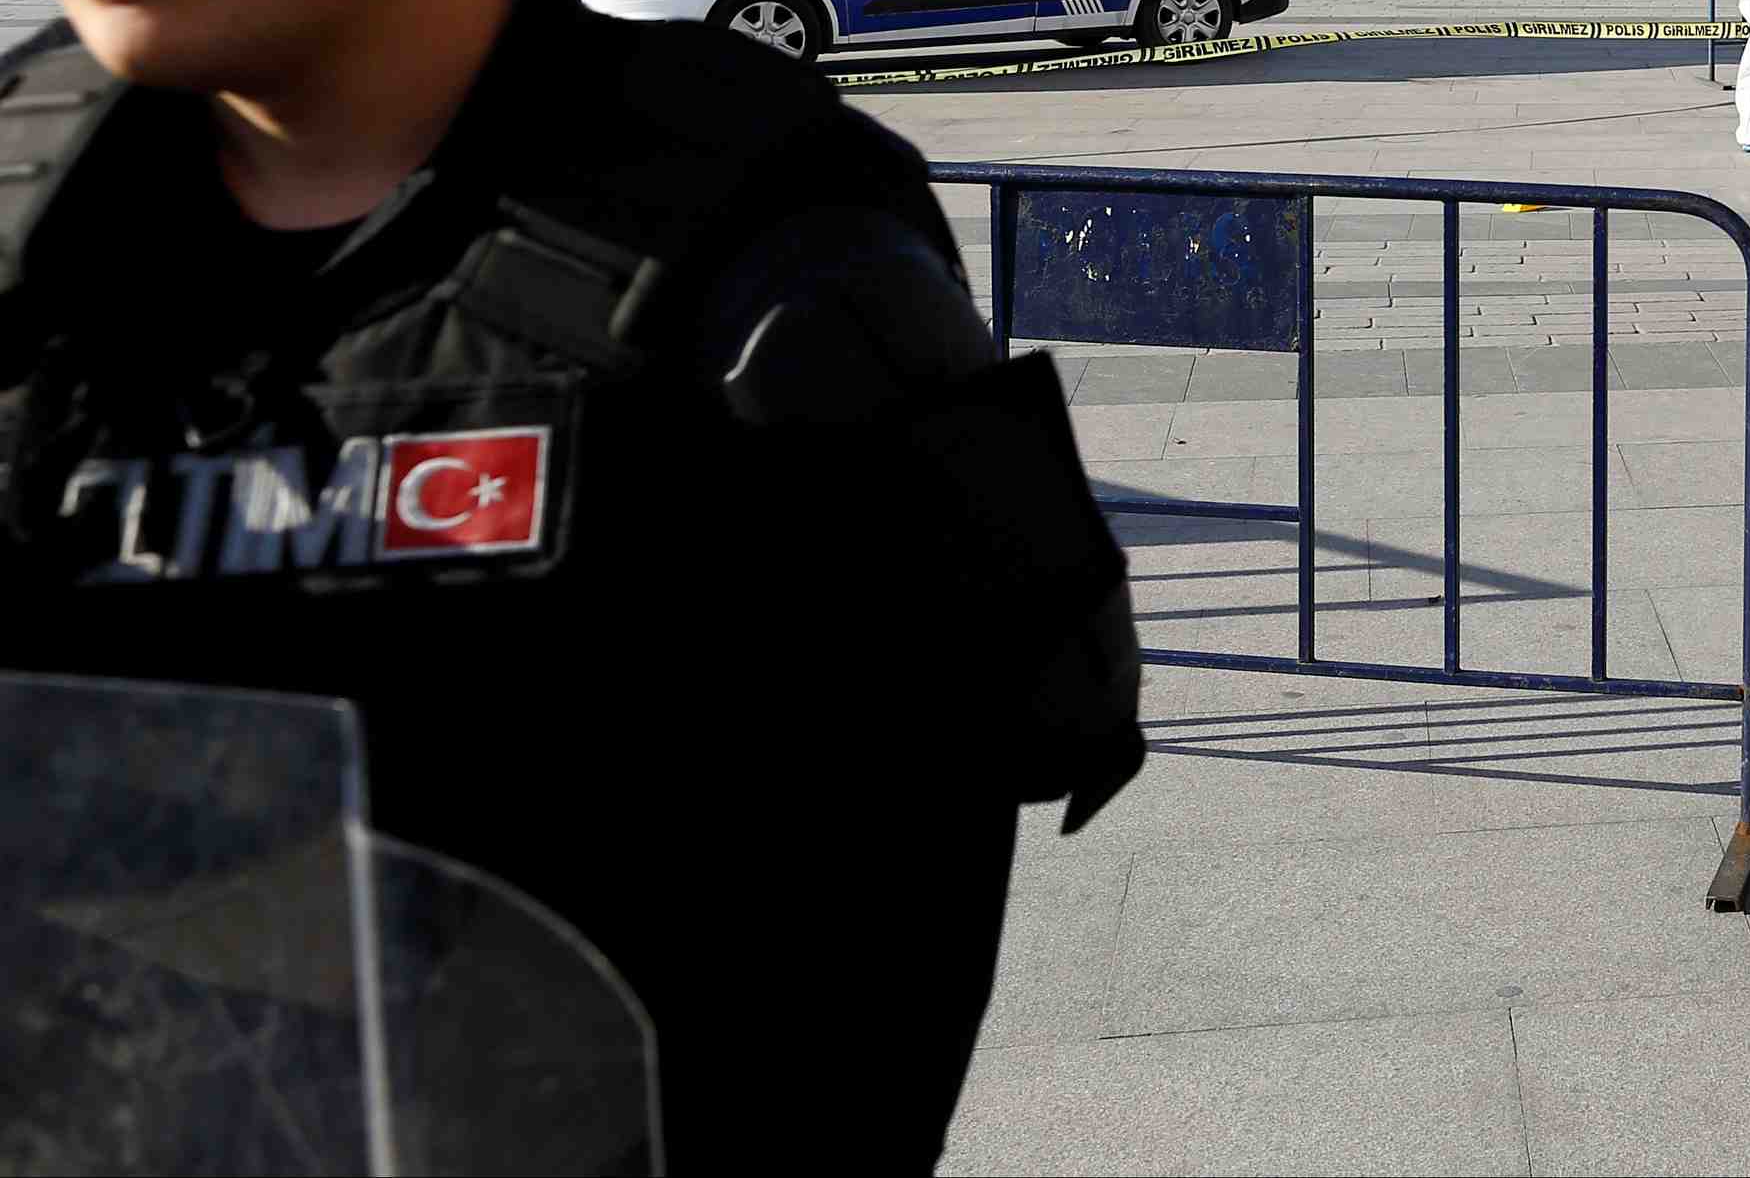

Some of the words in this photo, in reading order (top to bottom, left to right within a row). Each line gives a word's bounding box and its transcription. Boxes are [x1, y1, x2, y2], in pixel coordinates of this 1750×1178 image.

[1163, 37, 1254, 60] GİRİLMEZ
[1606, 25, 1645, 36] POLİS
[1663, 25, 1720, 37] GİRİLMEZ
